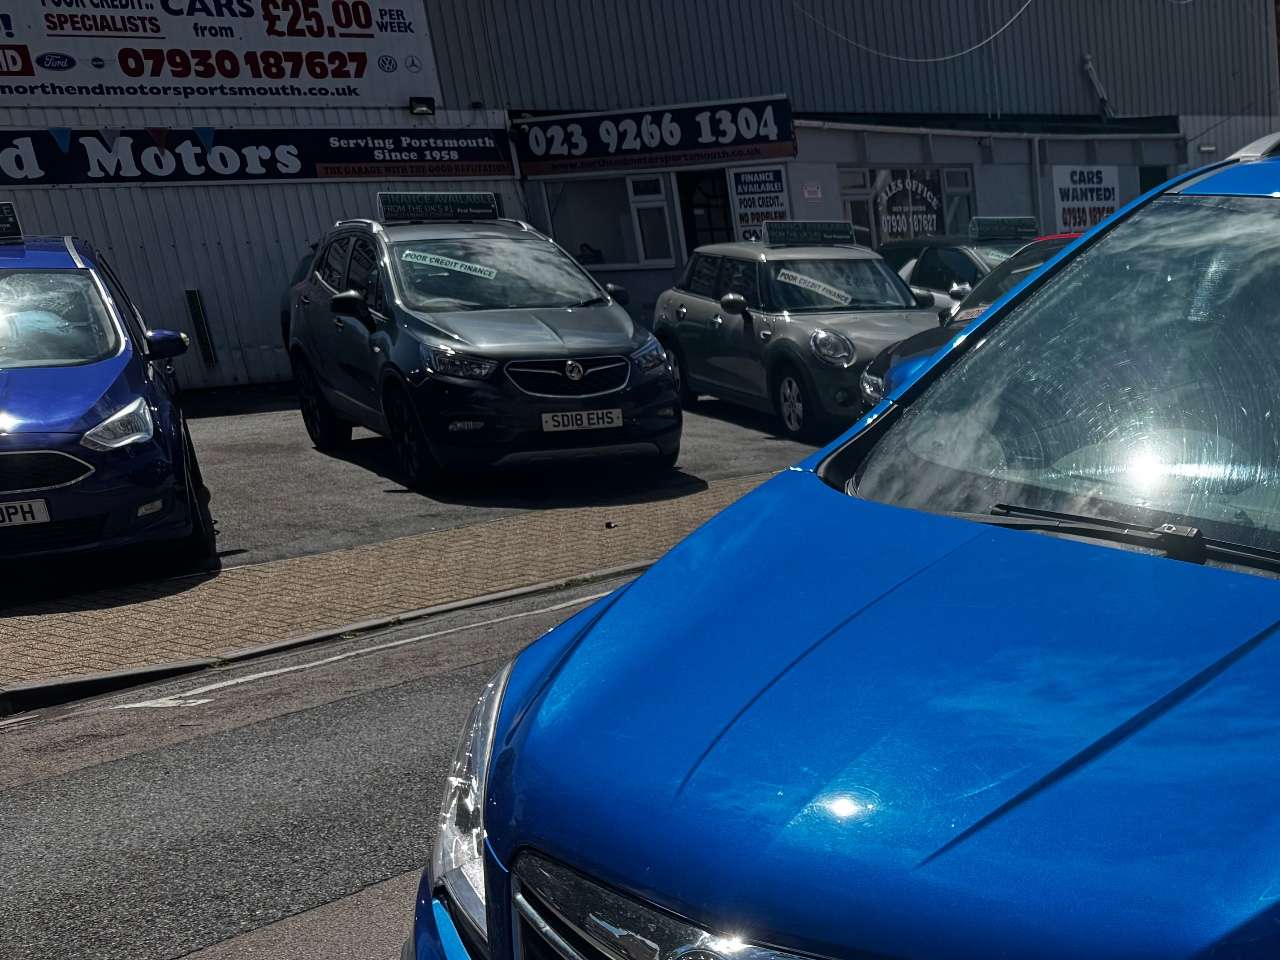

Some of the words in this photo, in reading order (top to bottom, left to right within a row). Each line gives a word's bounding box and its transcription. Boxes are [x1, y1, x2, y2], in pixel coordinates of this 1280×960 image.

[160, 0, 255, 18] CARS
[379, 8, 405, 21] PER
[44, 13, 161, 33] SPECIALISTS
[192, 22, 235, 38] from
[376, 20, 415, 34] WEEK
[117, 48, 240, 79] 07930
[243, 51, 367, 79] 187627
[528, 124, 588, 157] 023
[599, 113, 682, 154] 9266
[695, 105, 778, 144] 1304
[329, 136, 395, 150] Serving
[400, 136, 495, 149] Portsmouth
[79, 136, 302, 178] Motors
[374, 149, 418, 161] Since
[424, 149, 459, 161] 1958
[741, 171, 774, 182] FINANCE
[1070, 170, 1103, 185] CARS
[905, 179, 939, 211] OFFICE
[1059, 187, 1115, 202] WANTED!
[738, 197, 755, 209] POOR
[881, 214, 907, 233] 07930
[404, 252, 428, 262] POOR
[429, 257, 459, 269] CREDIT
[459, 263, 495, 278] FINANCE
[780, 271, 798, 283] POOR
[551, 413, 584, 428] SD18
[587, 411, 614, 426] EHS
